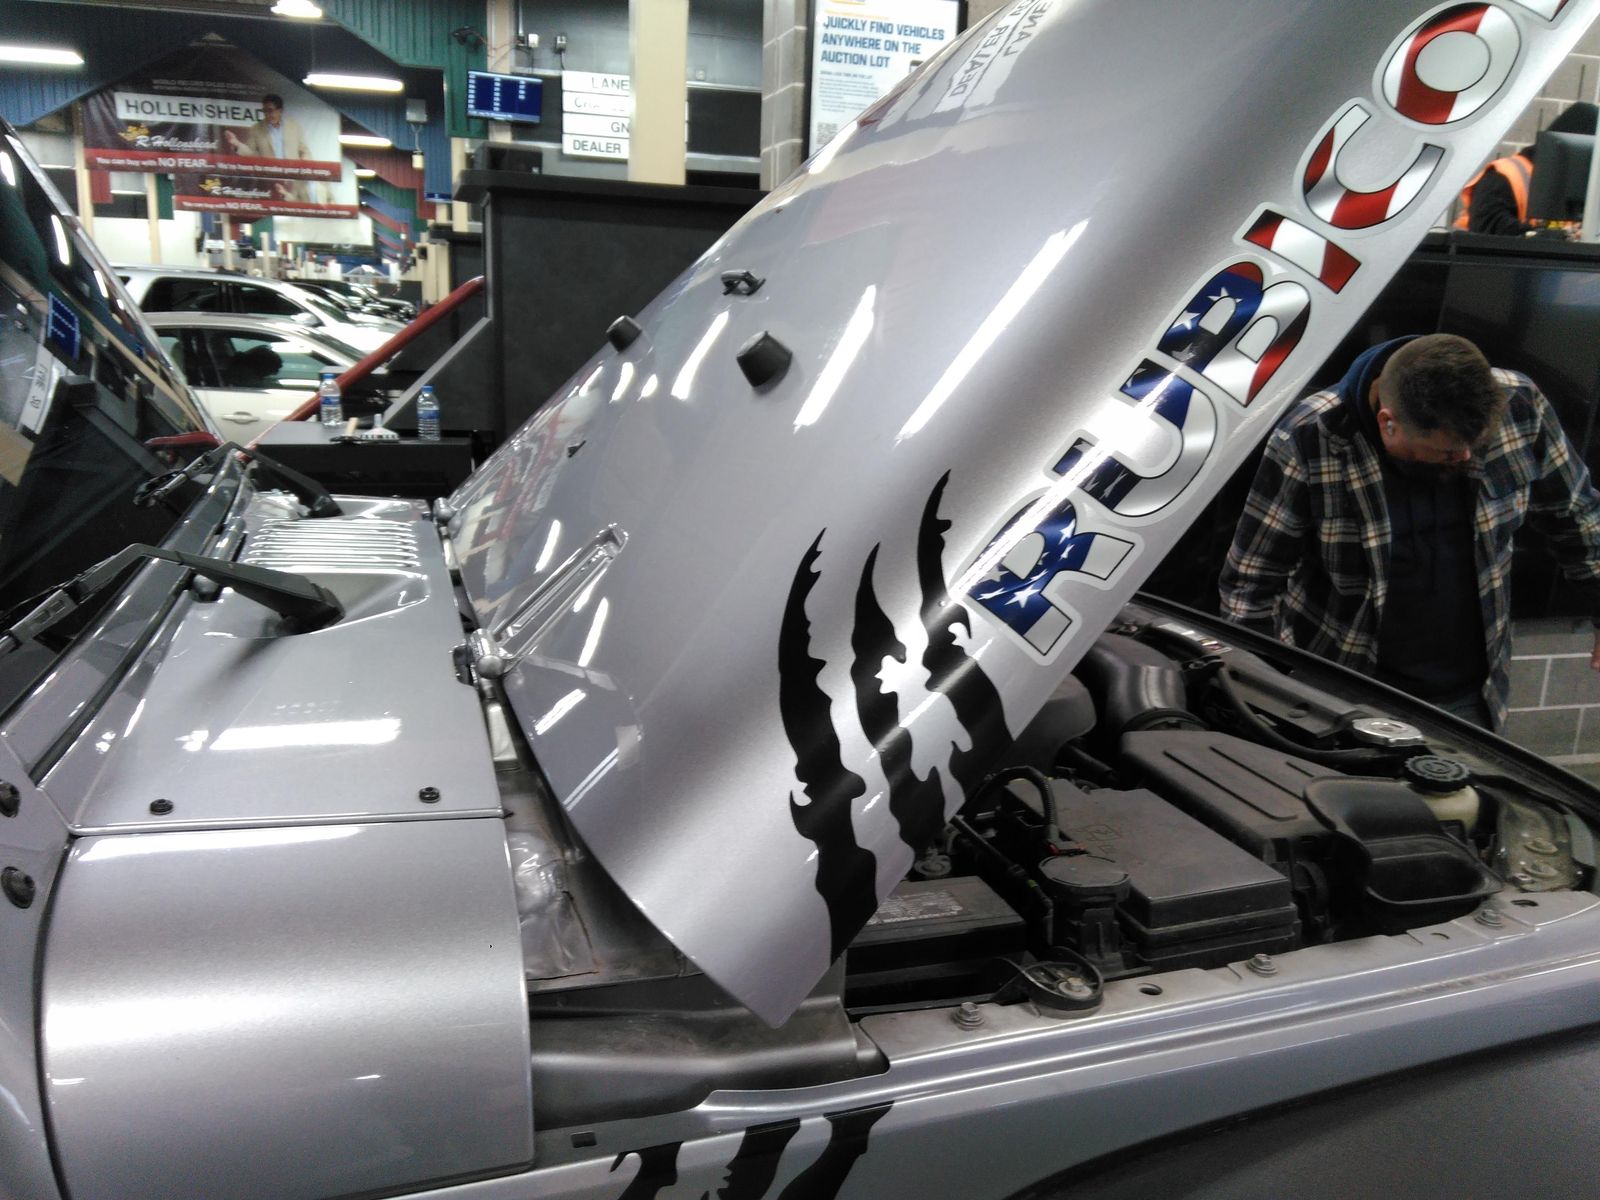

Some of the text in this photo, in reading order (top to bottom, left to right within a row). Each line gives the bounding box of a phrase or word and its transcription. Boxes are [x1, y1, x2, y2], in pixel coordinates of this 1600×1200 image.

[870, 21, 894, 35] FIND
[896, 24, 945, 40] VEHICLES
[822, 33, 922, 54] ANYWHERE ON THE
[821, 50, 891, 68] AUCTION LOT
[591, 76, 630, 92] LANE
[125, 98, 265, 122] HOLLENSHEAD
[573, 139, 622, 154] DEALER
[158, 157, 175, 167] NO
[956, 0, 1569, 657] RUBICO
